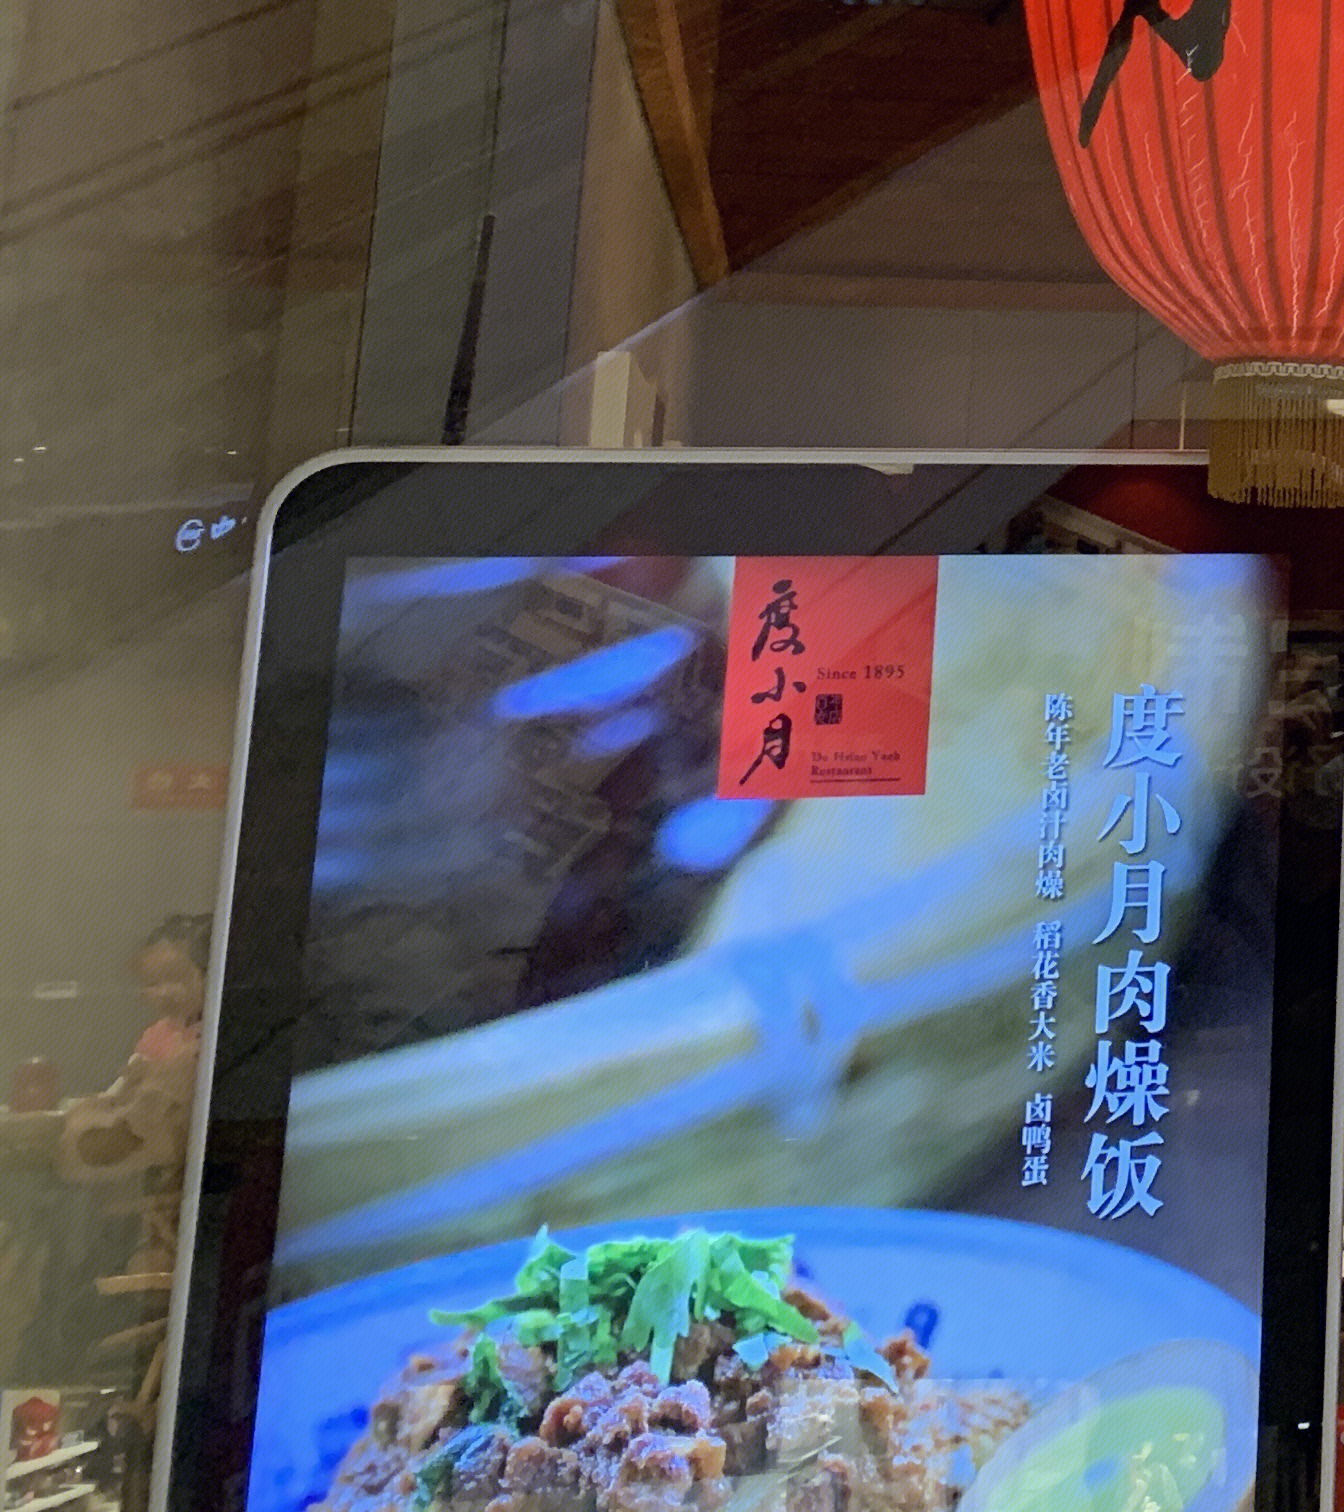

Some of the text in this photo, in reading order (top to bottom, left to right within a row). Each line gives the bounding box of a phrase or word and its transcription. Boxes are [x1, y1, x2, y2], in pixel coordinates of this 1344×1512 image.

[738, 579, 807, 785] 度小月
[817, 664, 905, 680] Since 1895
[1081, 683, 1186, 1220] 度小月肉燥饭
[1021, 1093, 1053, 1187] 卤鸭蛋
